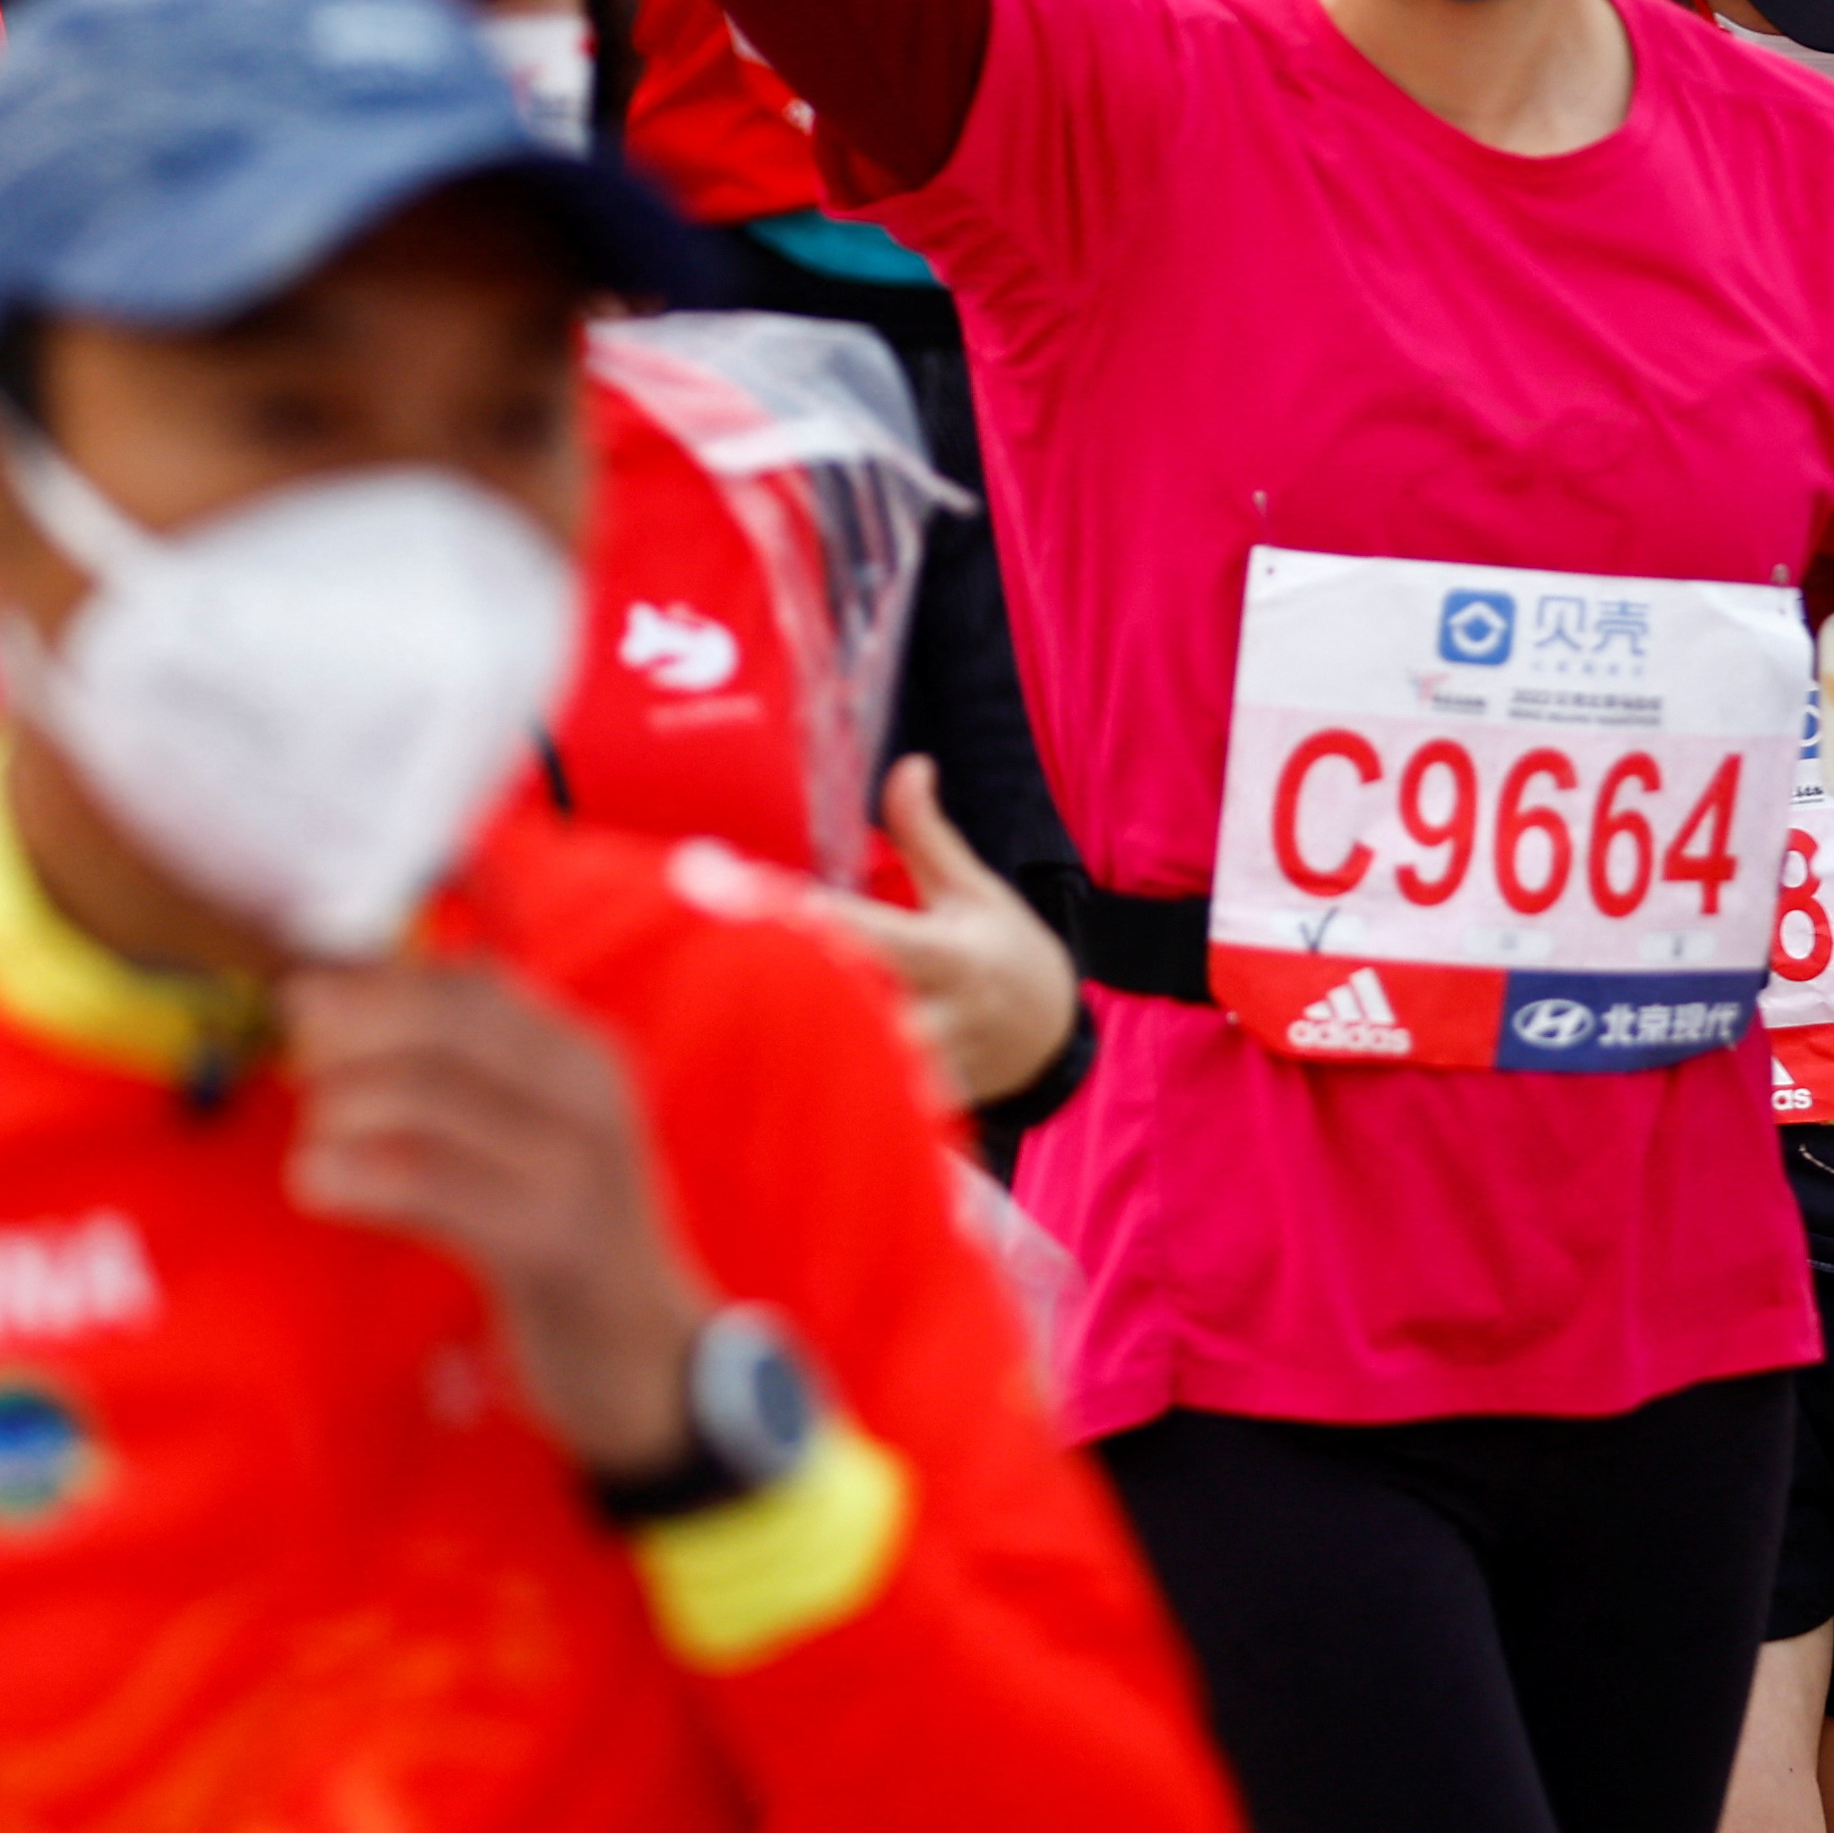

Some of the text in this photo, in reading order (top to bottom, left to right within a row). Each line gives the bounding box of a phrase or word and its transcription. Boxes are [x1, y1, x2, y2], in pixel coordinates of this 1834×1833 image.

[1533, 594, 1650, 656] 贝壳
[1271, 726, 1744, 920] C9664
[1287, 1018, 1412, 1055] adidas
[1597, 1000, 1741, 1048] 北京现代
